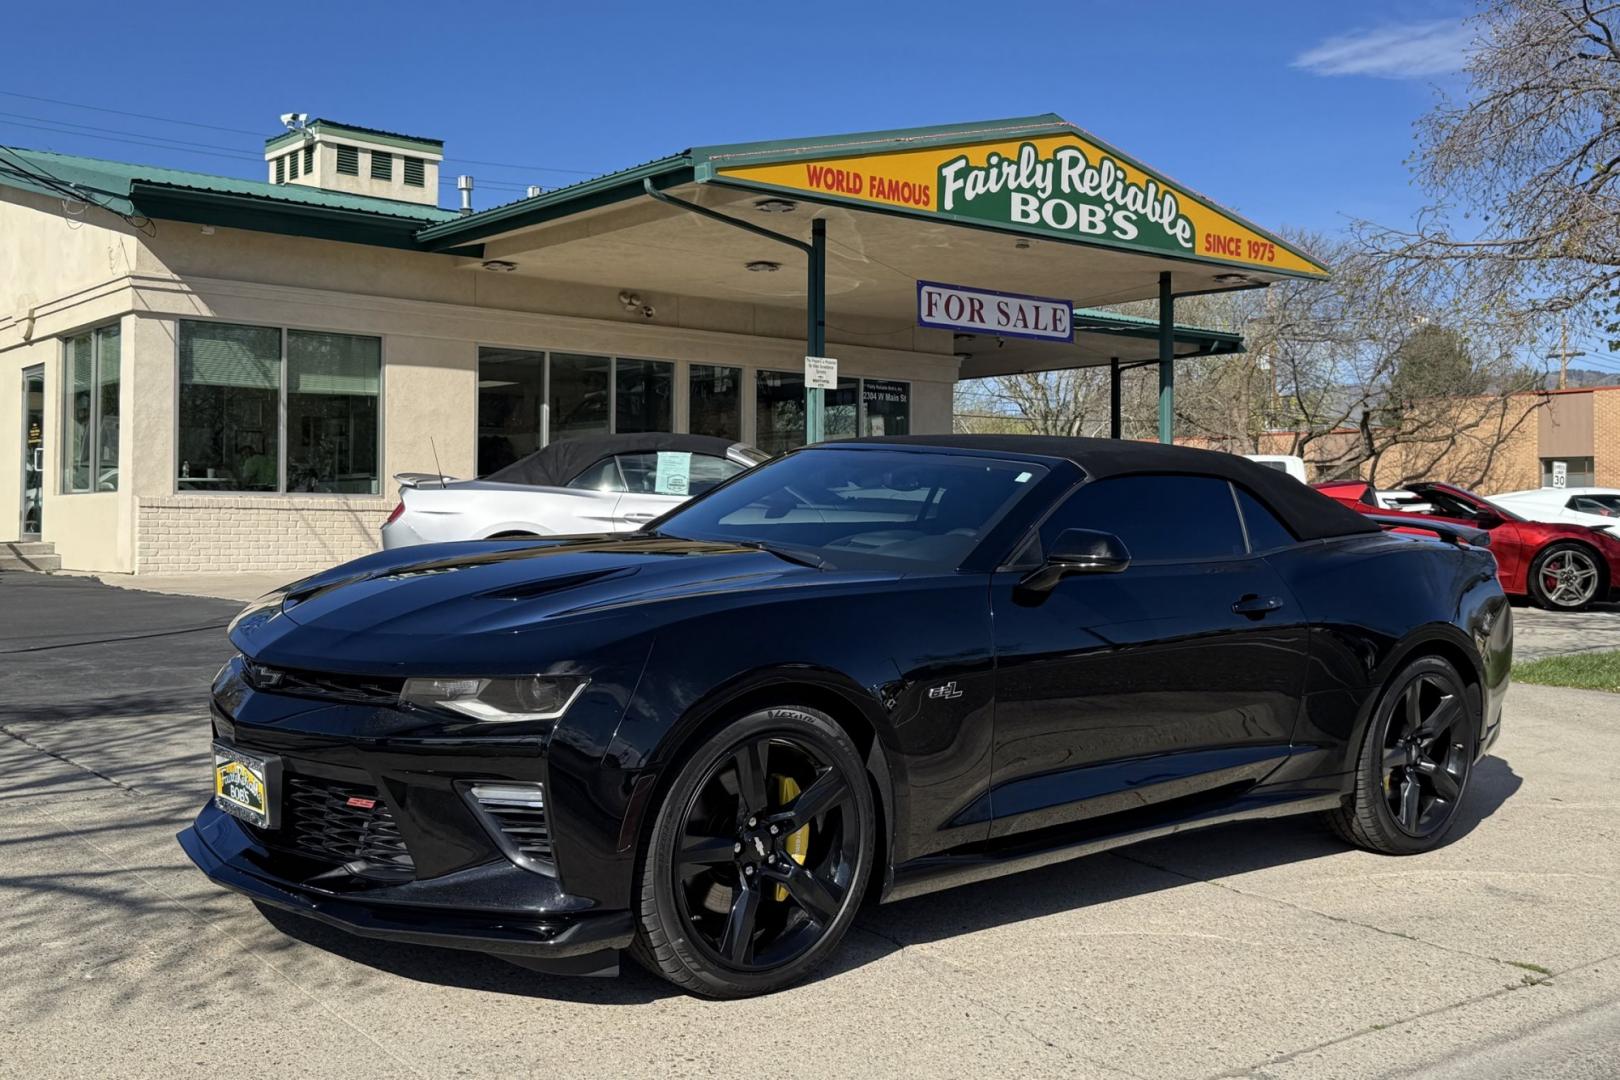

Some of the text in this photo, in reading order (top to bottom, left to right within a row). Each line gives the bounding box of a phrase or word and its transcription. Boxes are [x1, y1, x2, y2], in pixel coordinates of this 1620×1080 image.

[806, 164, 930, 207] WORLD FAMOUS
[942, 146, 1193, 248] Fairly Reliable
[1010, 192, 1139, 241] BOB'S
[1204, 232, 1275, 262] SINCE 1975
[925, 290, 1067, 333] FOR SALE
[863, 391, 877, 401] 2304
[877, 392, 885, 401] W
[885, 392, 899, 402] Main
[1554, 475, 1564, 486] 30
